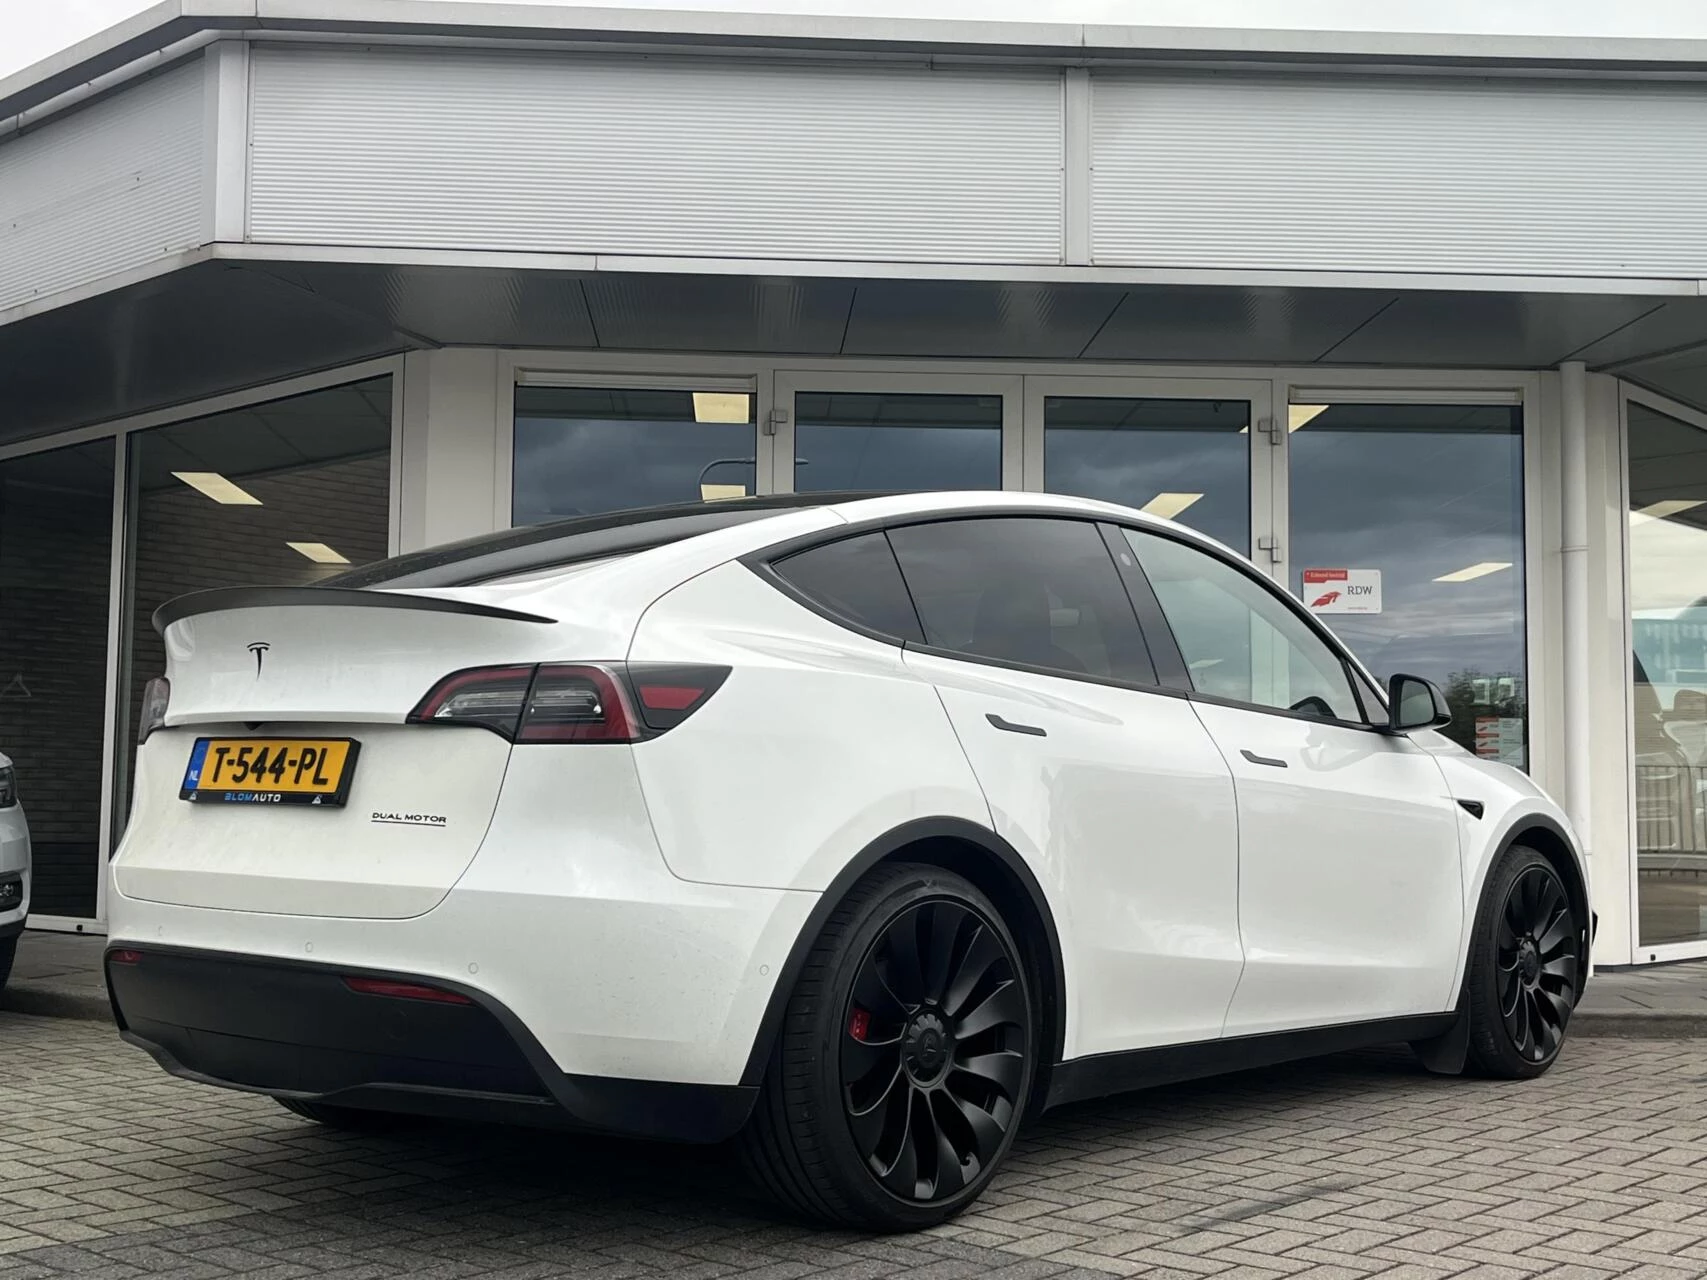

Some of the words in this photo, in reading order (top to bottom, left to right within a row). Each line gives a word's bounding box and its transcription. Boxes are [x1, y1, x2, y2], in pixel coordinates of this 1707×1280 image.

[1347, 585, 1372, 595] RDW
[212, 747, 329, 786] T-544-PL
[188, 769, 199, 781] NL
[224, 792, 282, 803] BLOMAUTO
[372, 812, 402, 821] DUAL
[404, 814, 447, 823] MOTOR
